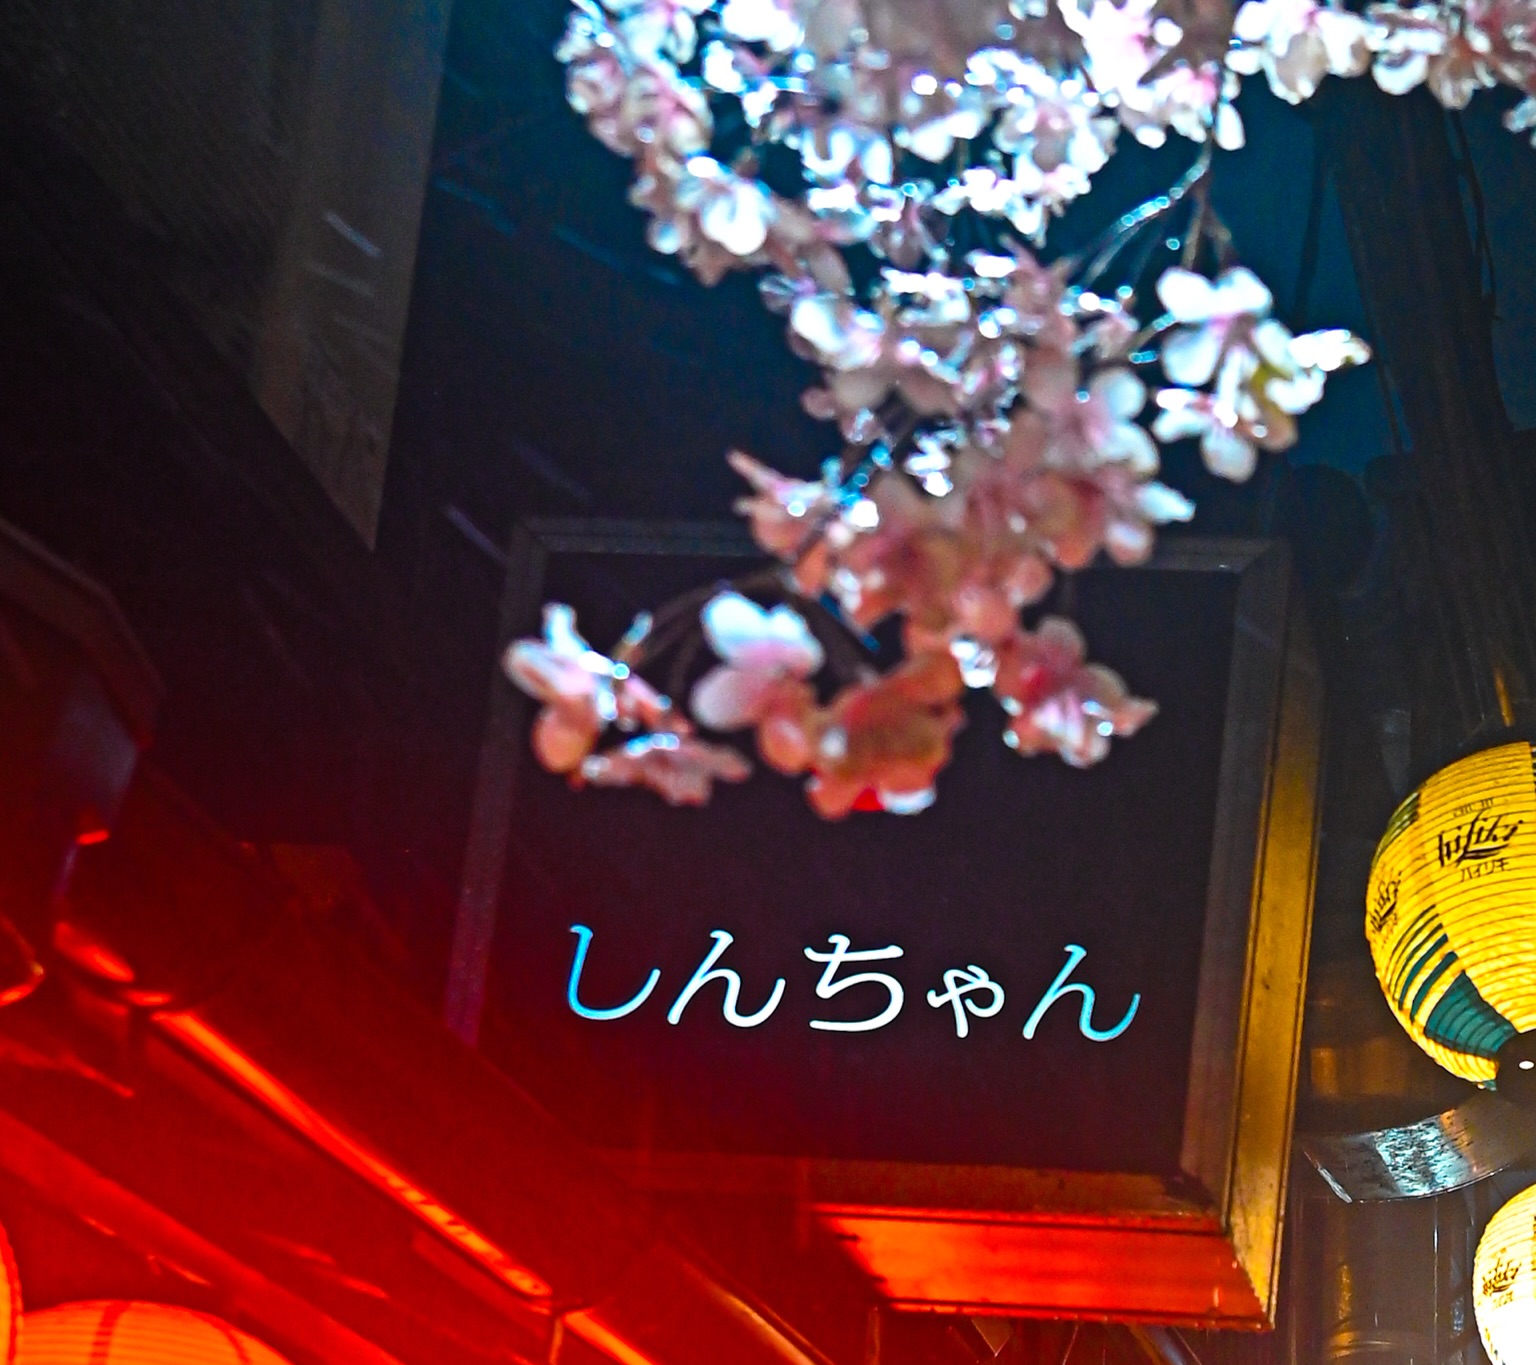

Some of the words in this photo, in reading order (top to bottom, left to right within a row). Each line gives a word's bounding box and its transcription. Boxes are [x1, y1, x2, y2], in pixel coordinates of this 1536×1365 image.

[567, 923, 1141, 1042] しんちゃん
